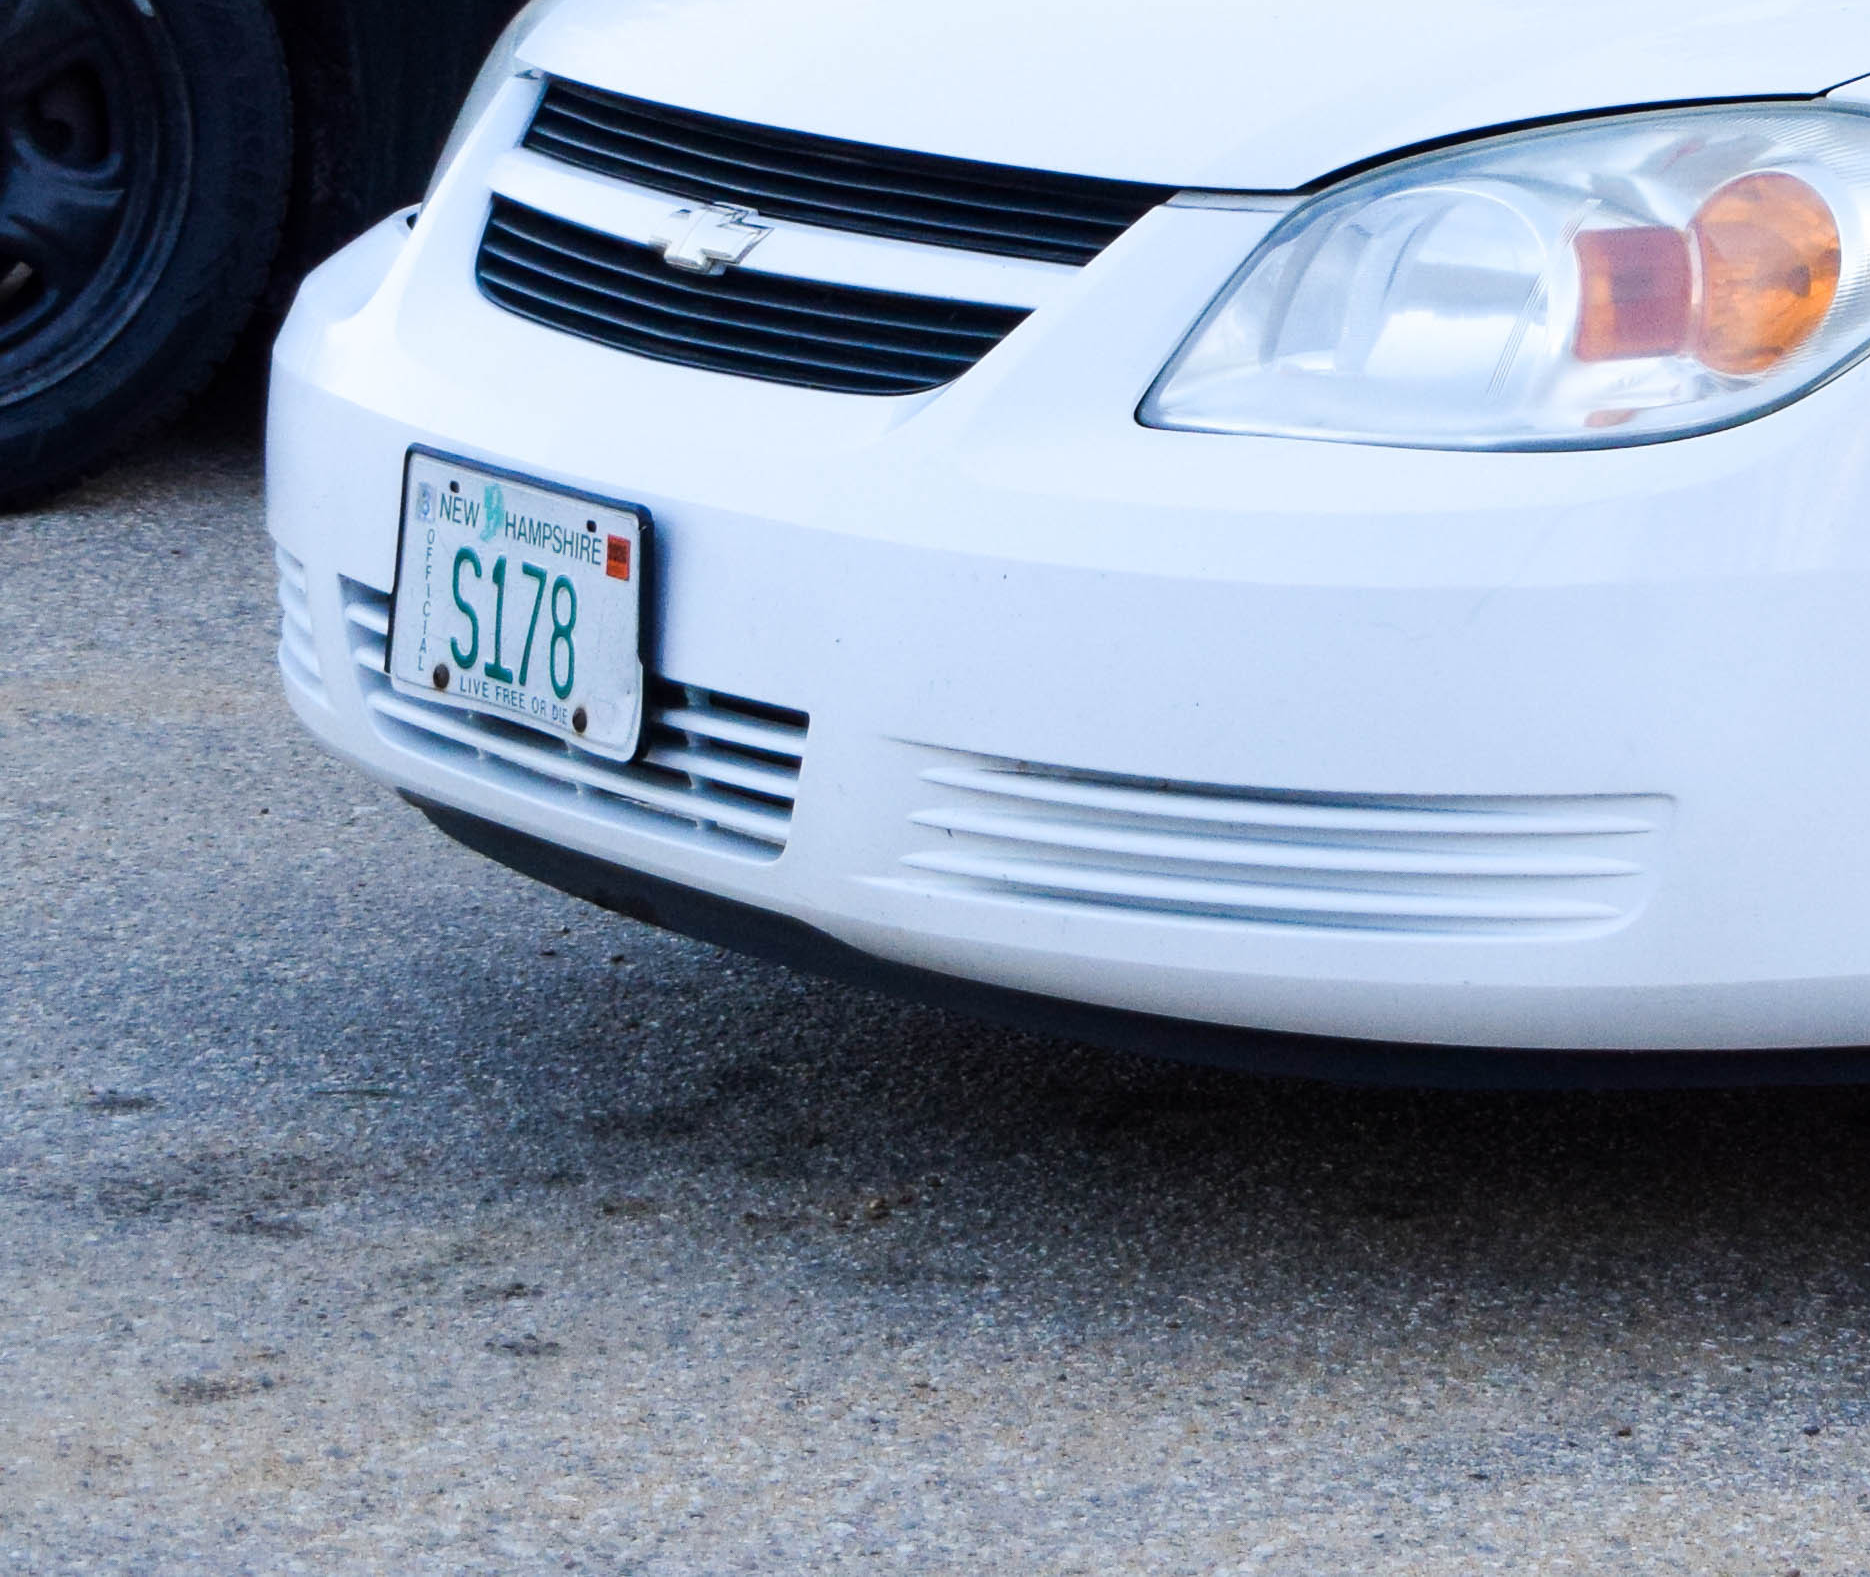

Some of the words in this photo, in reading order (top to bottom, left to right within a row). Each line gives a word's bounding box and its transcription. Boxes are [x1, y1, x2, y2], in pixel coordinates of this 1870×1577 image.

[439, 493, 480, 529] NEW
[504, 511, 603, 567] HAMPSHIRE
[418, 528, 435, 672] OFFICIAL
[450, 545, 578, 700] S178
[459, 675, 489, 698] LIVE
[495, 686, 526, 710] FREE
[531, 696, 547, 715] OR
[552, 705, 569, 726] DIE
